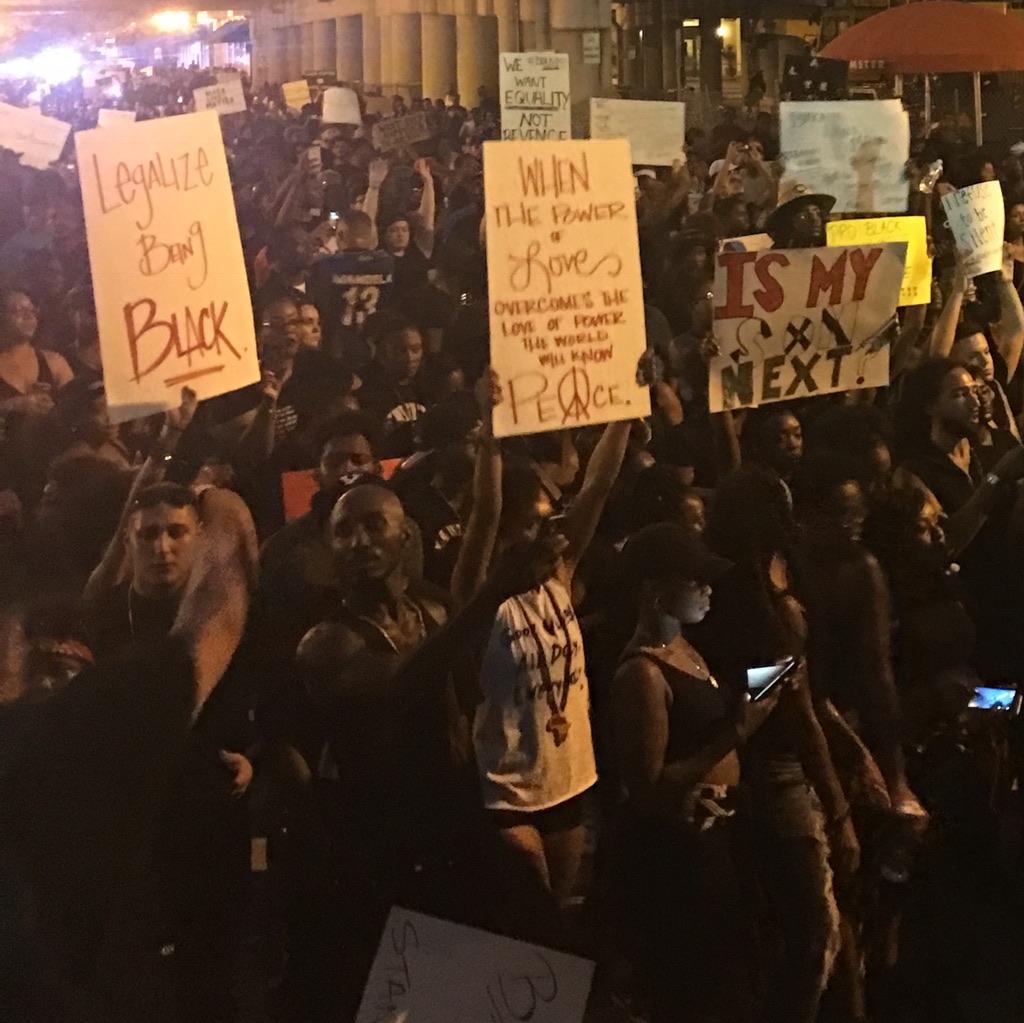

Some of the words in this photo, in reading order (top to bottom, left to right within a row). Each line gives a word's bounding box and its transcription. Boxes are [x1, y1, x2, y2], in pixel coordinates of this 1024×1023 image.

[503, 57, 523, 72] WE
[514, 76, 547, 89] WANT
[504, 90, 571, 111] EQUALITY
[519, 112, 553, 128] NOT
[518, 152, 590, 199] WHEN
[493, 202, 540, 228] THE
[551, 202, 628, 226] POWER
[864, 220, 902, 236] BLACK
[714, 251, 791, 320] IS
[806, 247, 883, 309] MY
[602, 288, 629, 307] THE
[501, 319, 537, 338] LOVE
[546, 317, 564, 332] OF
[573, 310, 627, 328] POWER
[553, 331, 609, 348] WORLD
[570, 344, 614, 364] KNOW
